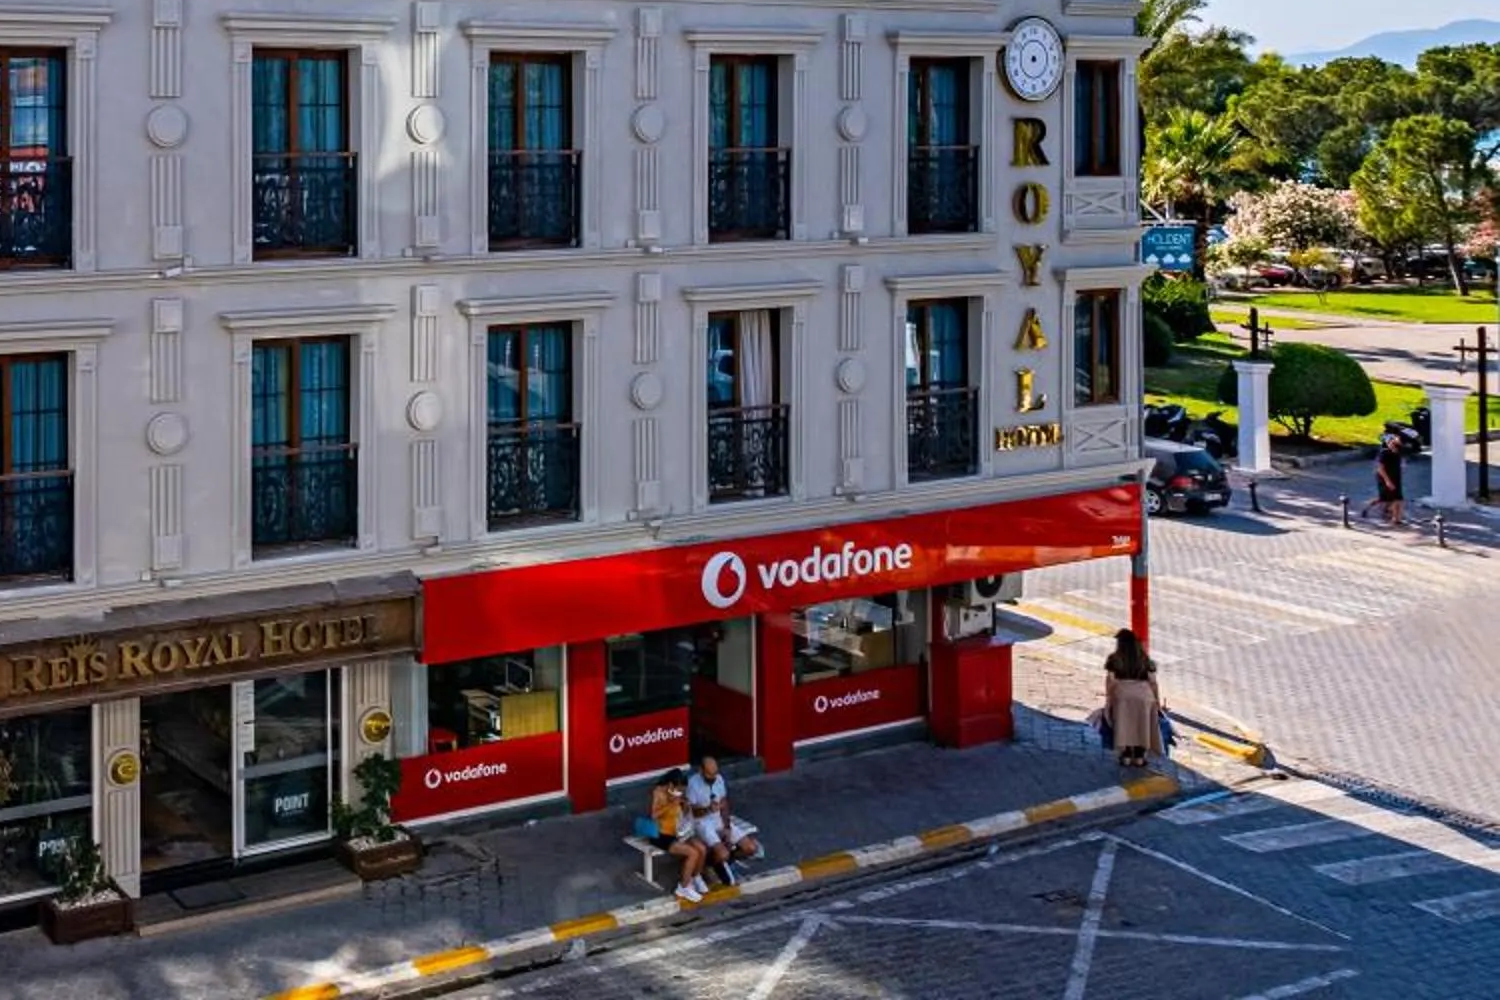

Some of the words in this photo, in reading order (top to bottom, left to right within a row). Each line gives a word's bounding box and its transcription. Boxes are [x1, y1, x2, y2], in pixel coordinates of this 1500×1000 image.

[1011, 117, 1049, 413] ROYAL
[757, 541, 913, 589] vodafone
[829, 689, 880, 709] vodafone
[627, 726, 683, 748] vodafone
[444, 761, 507, 783] vodafone
[275, 792, 309, 813] POINT
